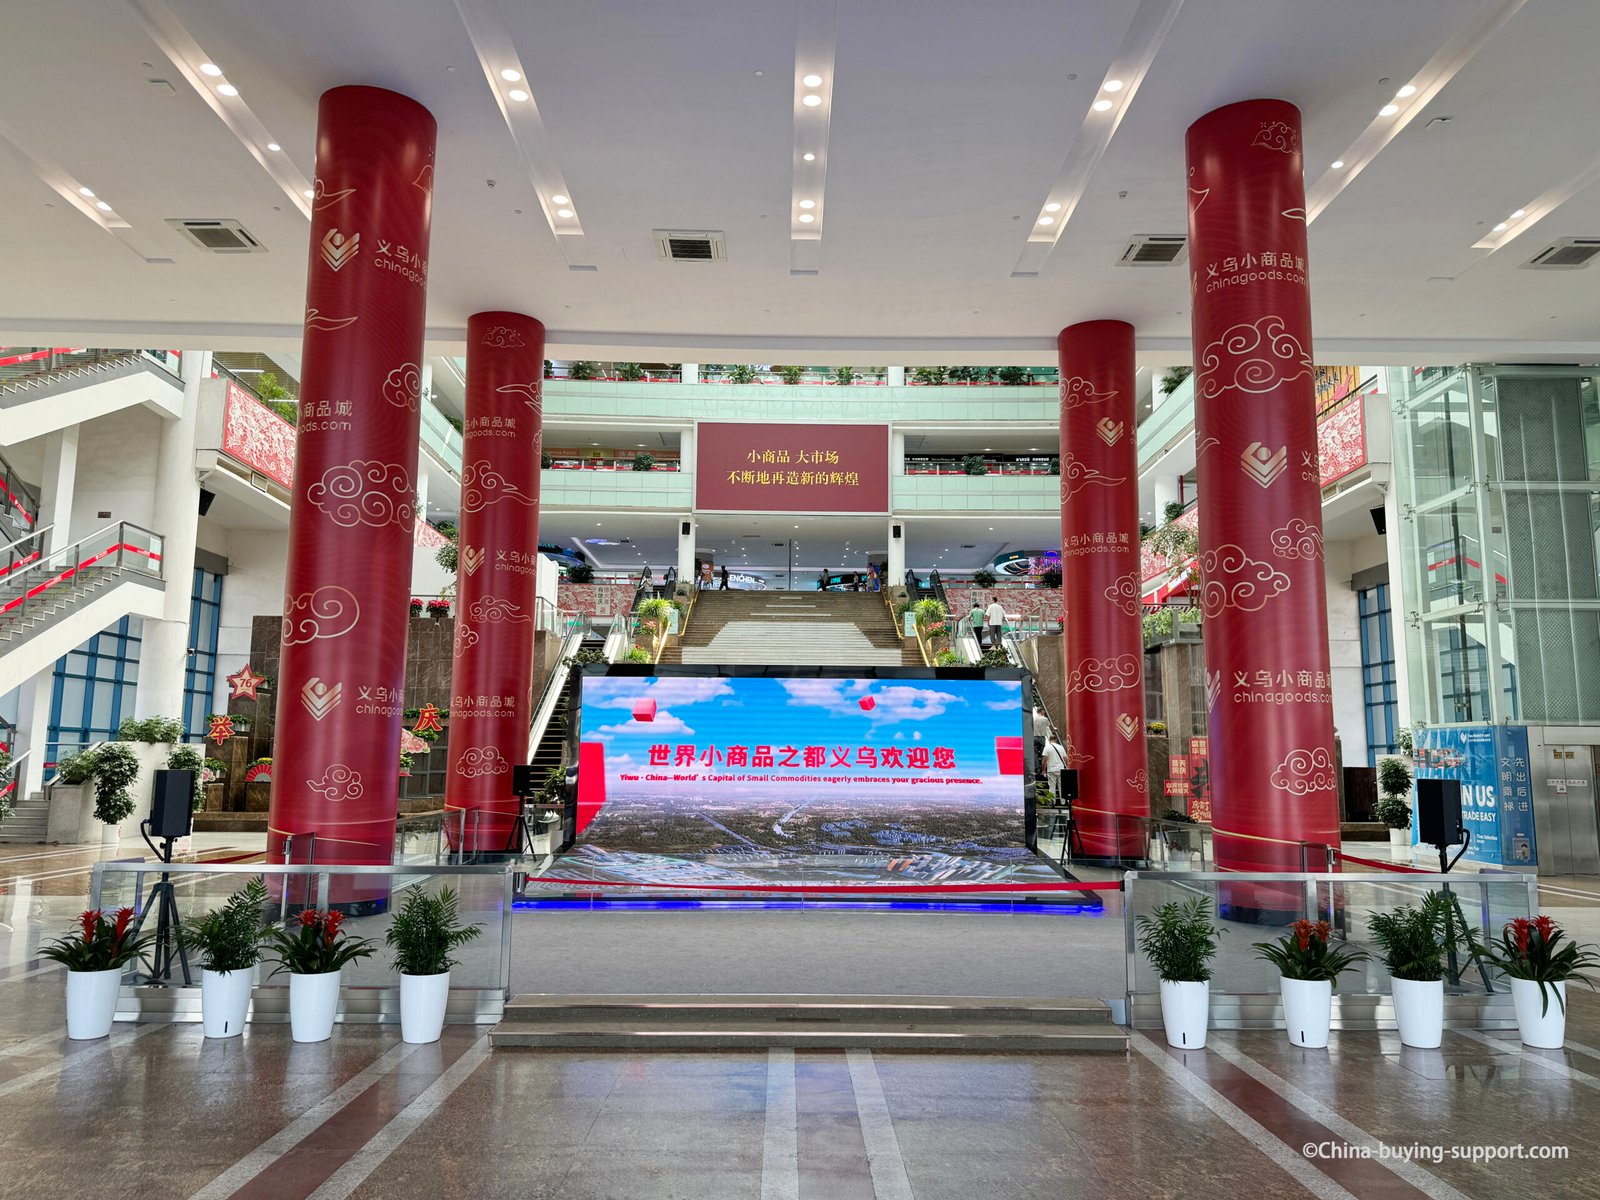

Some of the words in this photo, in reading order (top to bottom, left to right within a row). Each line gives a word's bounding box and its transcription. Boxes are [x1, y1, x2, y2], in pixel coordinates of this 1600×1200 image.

[1206, 251, 1305, 280] 义乌小商品城
[1206, 270, 1306, 293] chinagoods.com
[299, 400, 352, 419] 商品城
[746, 449, 790, 464] 小商品
[795, 449, 839, 464] 大市场
[726, 470, 859, 486] 不断地再造新的辉煌
[239, 678, 252, 688] 76
[412, 702, 443, 732] 庆
[207, 715, 235, 746] 举
[648, 744, 957, 770] 世界小商品之都义乌欢迎您
[620, 773, 639, 782] Yiwu
[708, 774, 735, 783] Capital
[737, 774, 746, 782] of
[747, 774, 769, 782] Small
[771, 774, 821, 783] Commodities
[823, 775, 851, 785] eagerly
[853, 775, 890, 784] embraces
[891, 777, 910, 785] your
[911, 776, 944, 786] gracious
[1515, 757, 1528, 812] 先出后进
[1475, 785, 1495, 808] US
[1480, 811, 1496, 822] EASY
